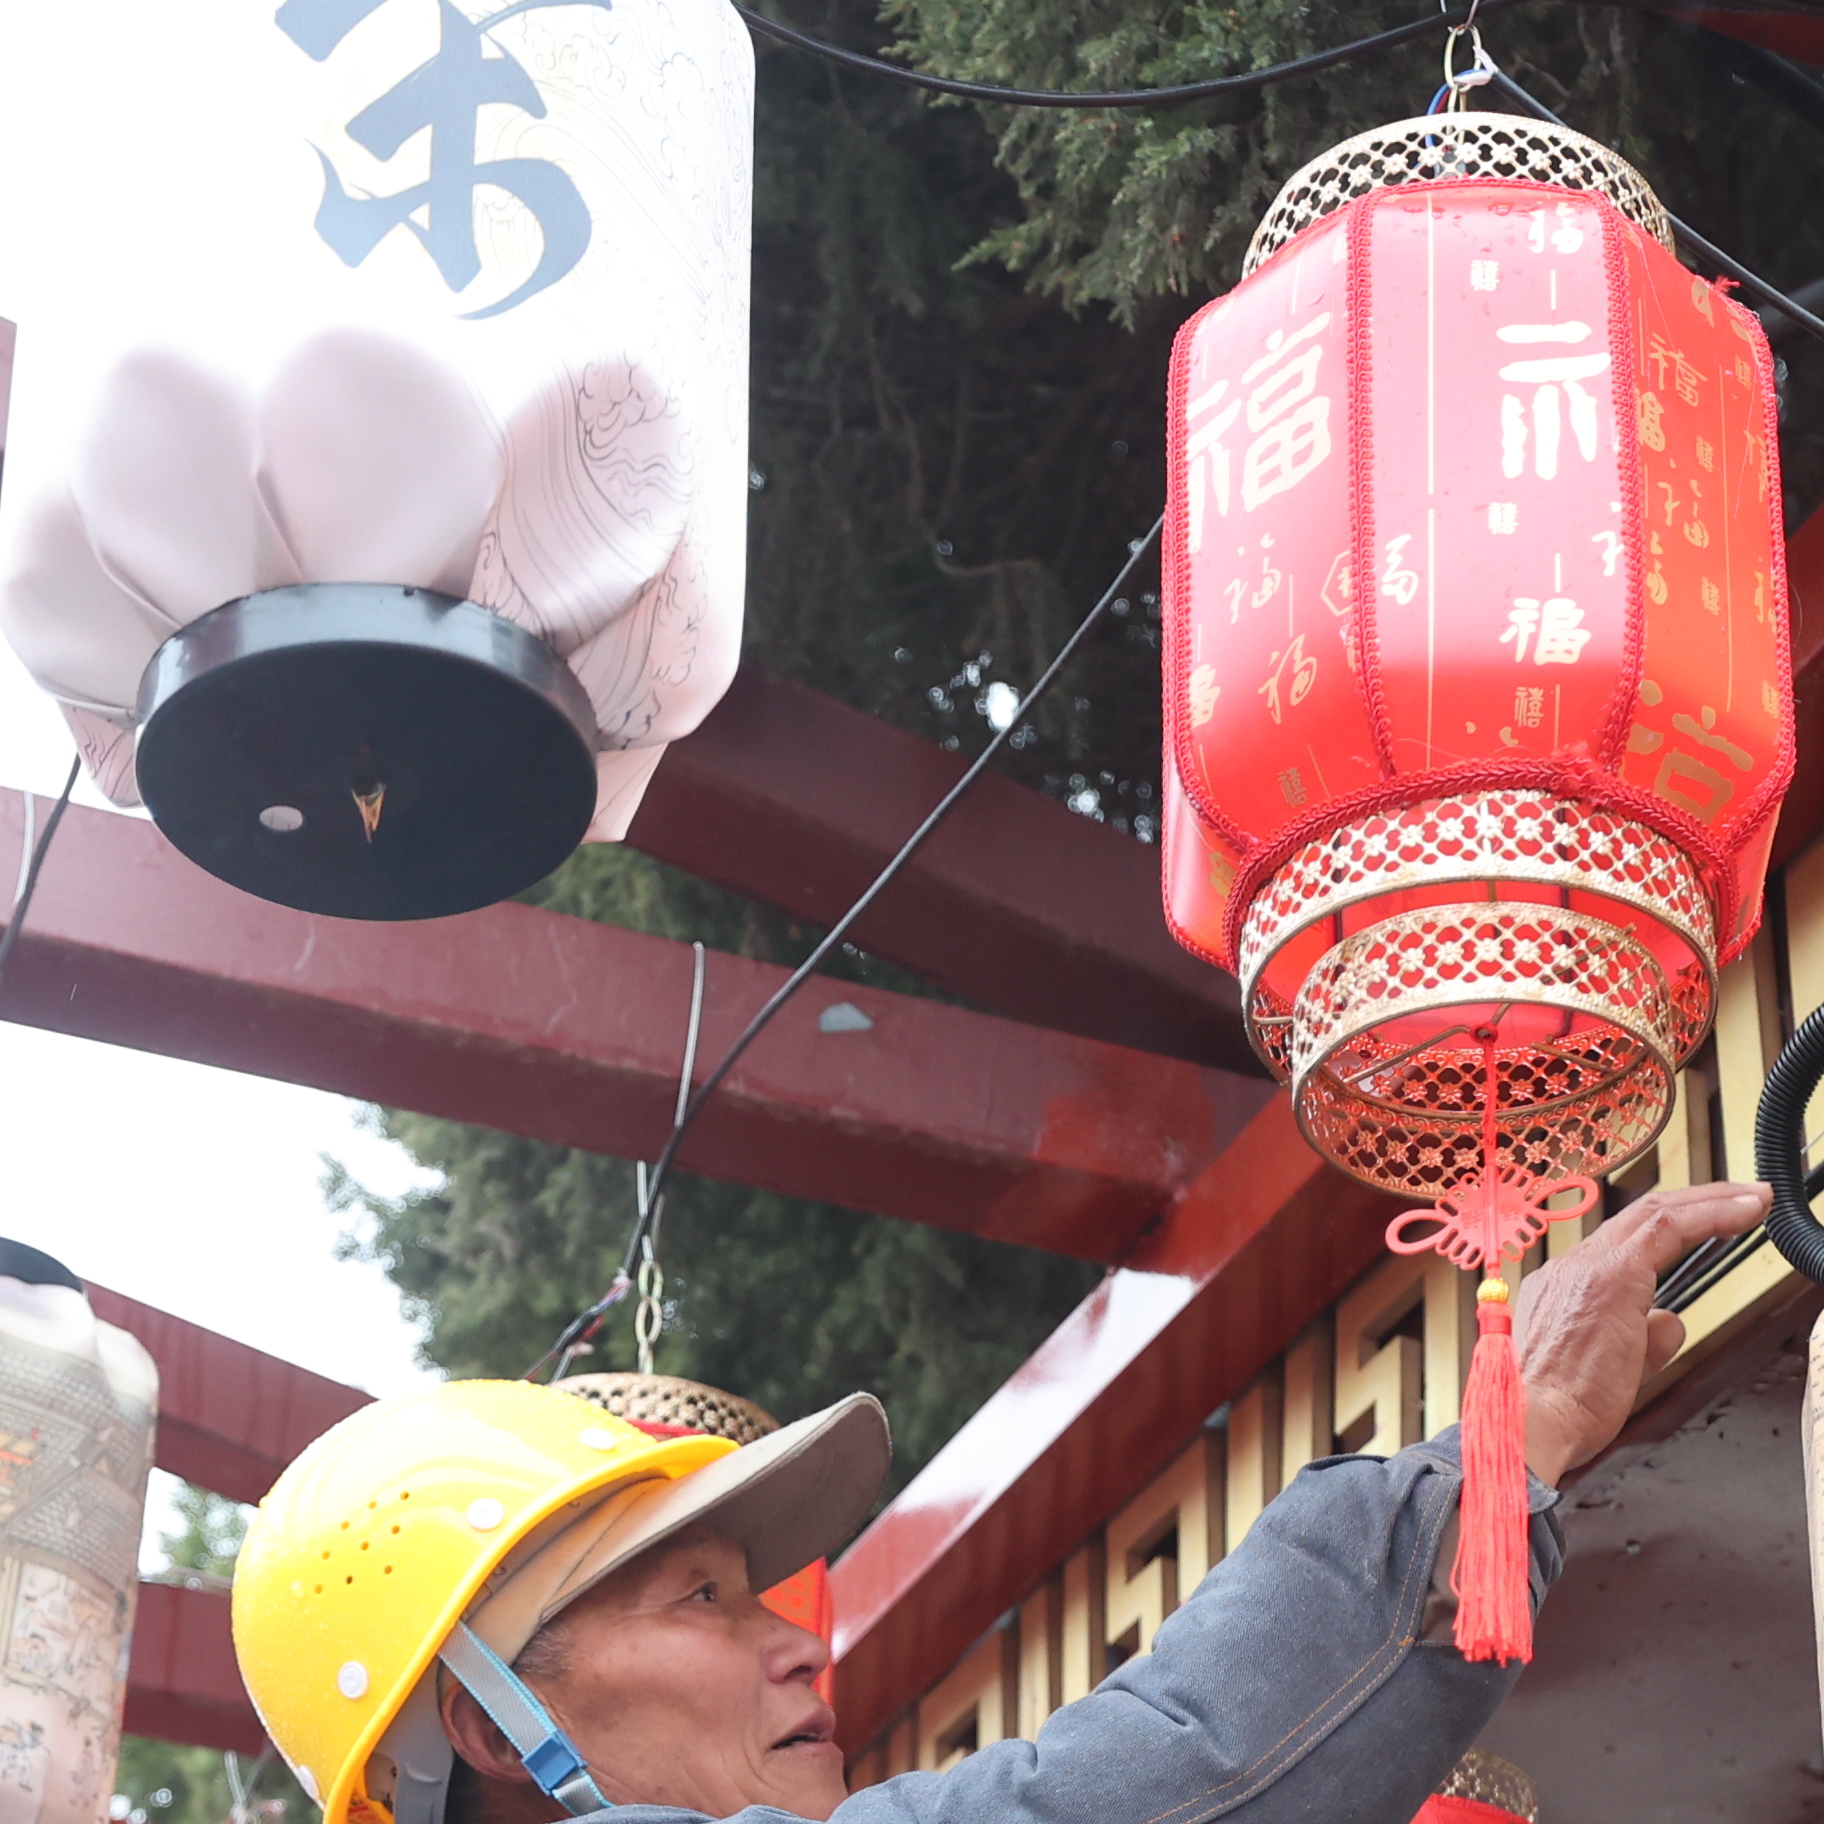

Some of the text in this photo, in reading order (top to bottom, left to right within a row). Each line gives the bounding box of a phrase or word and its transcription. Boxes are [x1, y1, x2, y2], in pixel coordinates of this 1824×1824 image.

[1498, 597, 1592, 666] 福
[1257, 633, 1318, 726] 福
[1513, 686, 1545, 728] 禧
